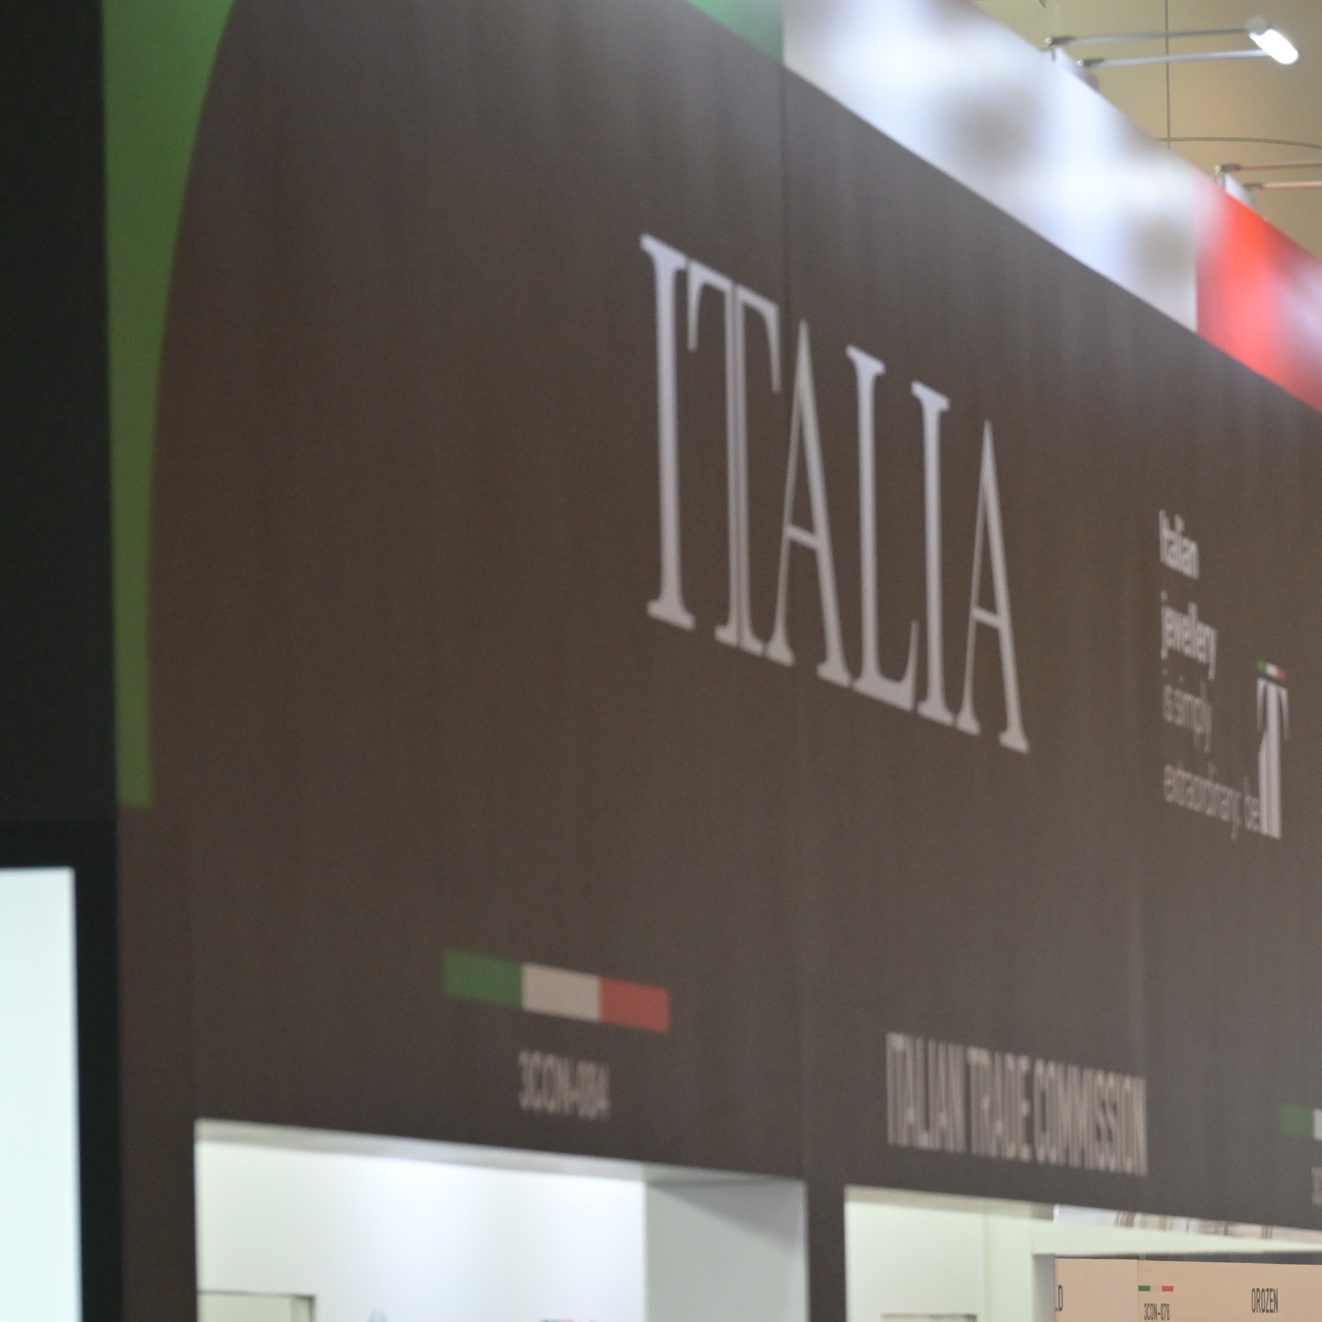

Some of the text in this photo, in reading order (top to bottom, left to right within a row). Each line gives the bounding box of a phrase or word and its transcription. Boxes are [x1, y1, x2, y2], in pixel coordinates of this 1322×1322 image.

[640, 233, 1030, 754] ITALIA
[886, 1031, 1149, 1177] ITALIAN TRADE COMMISSION
[1251, 1288, 1279, 1313] OROZEN
